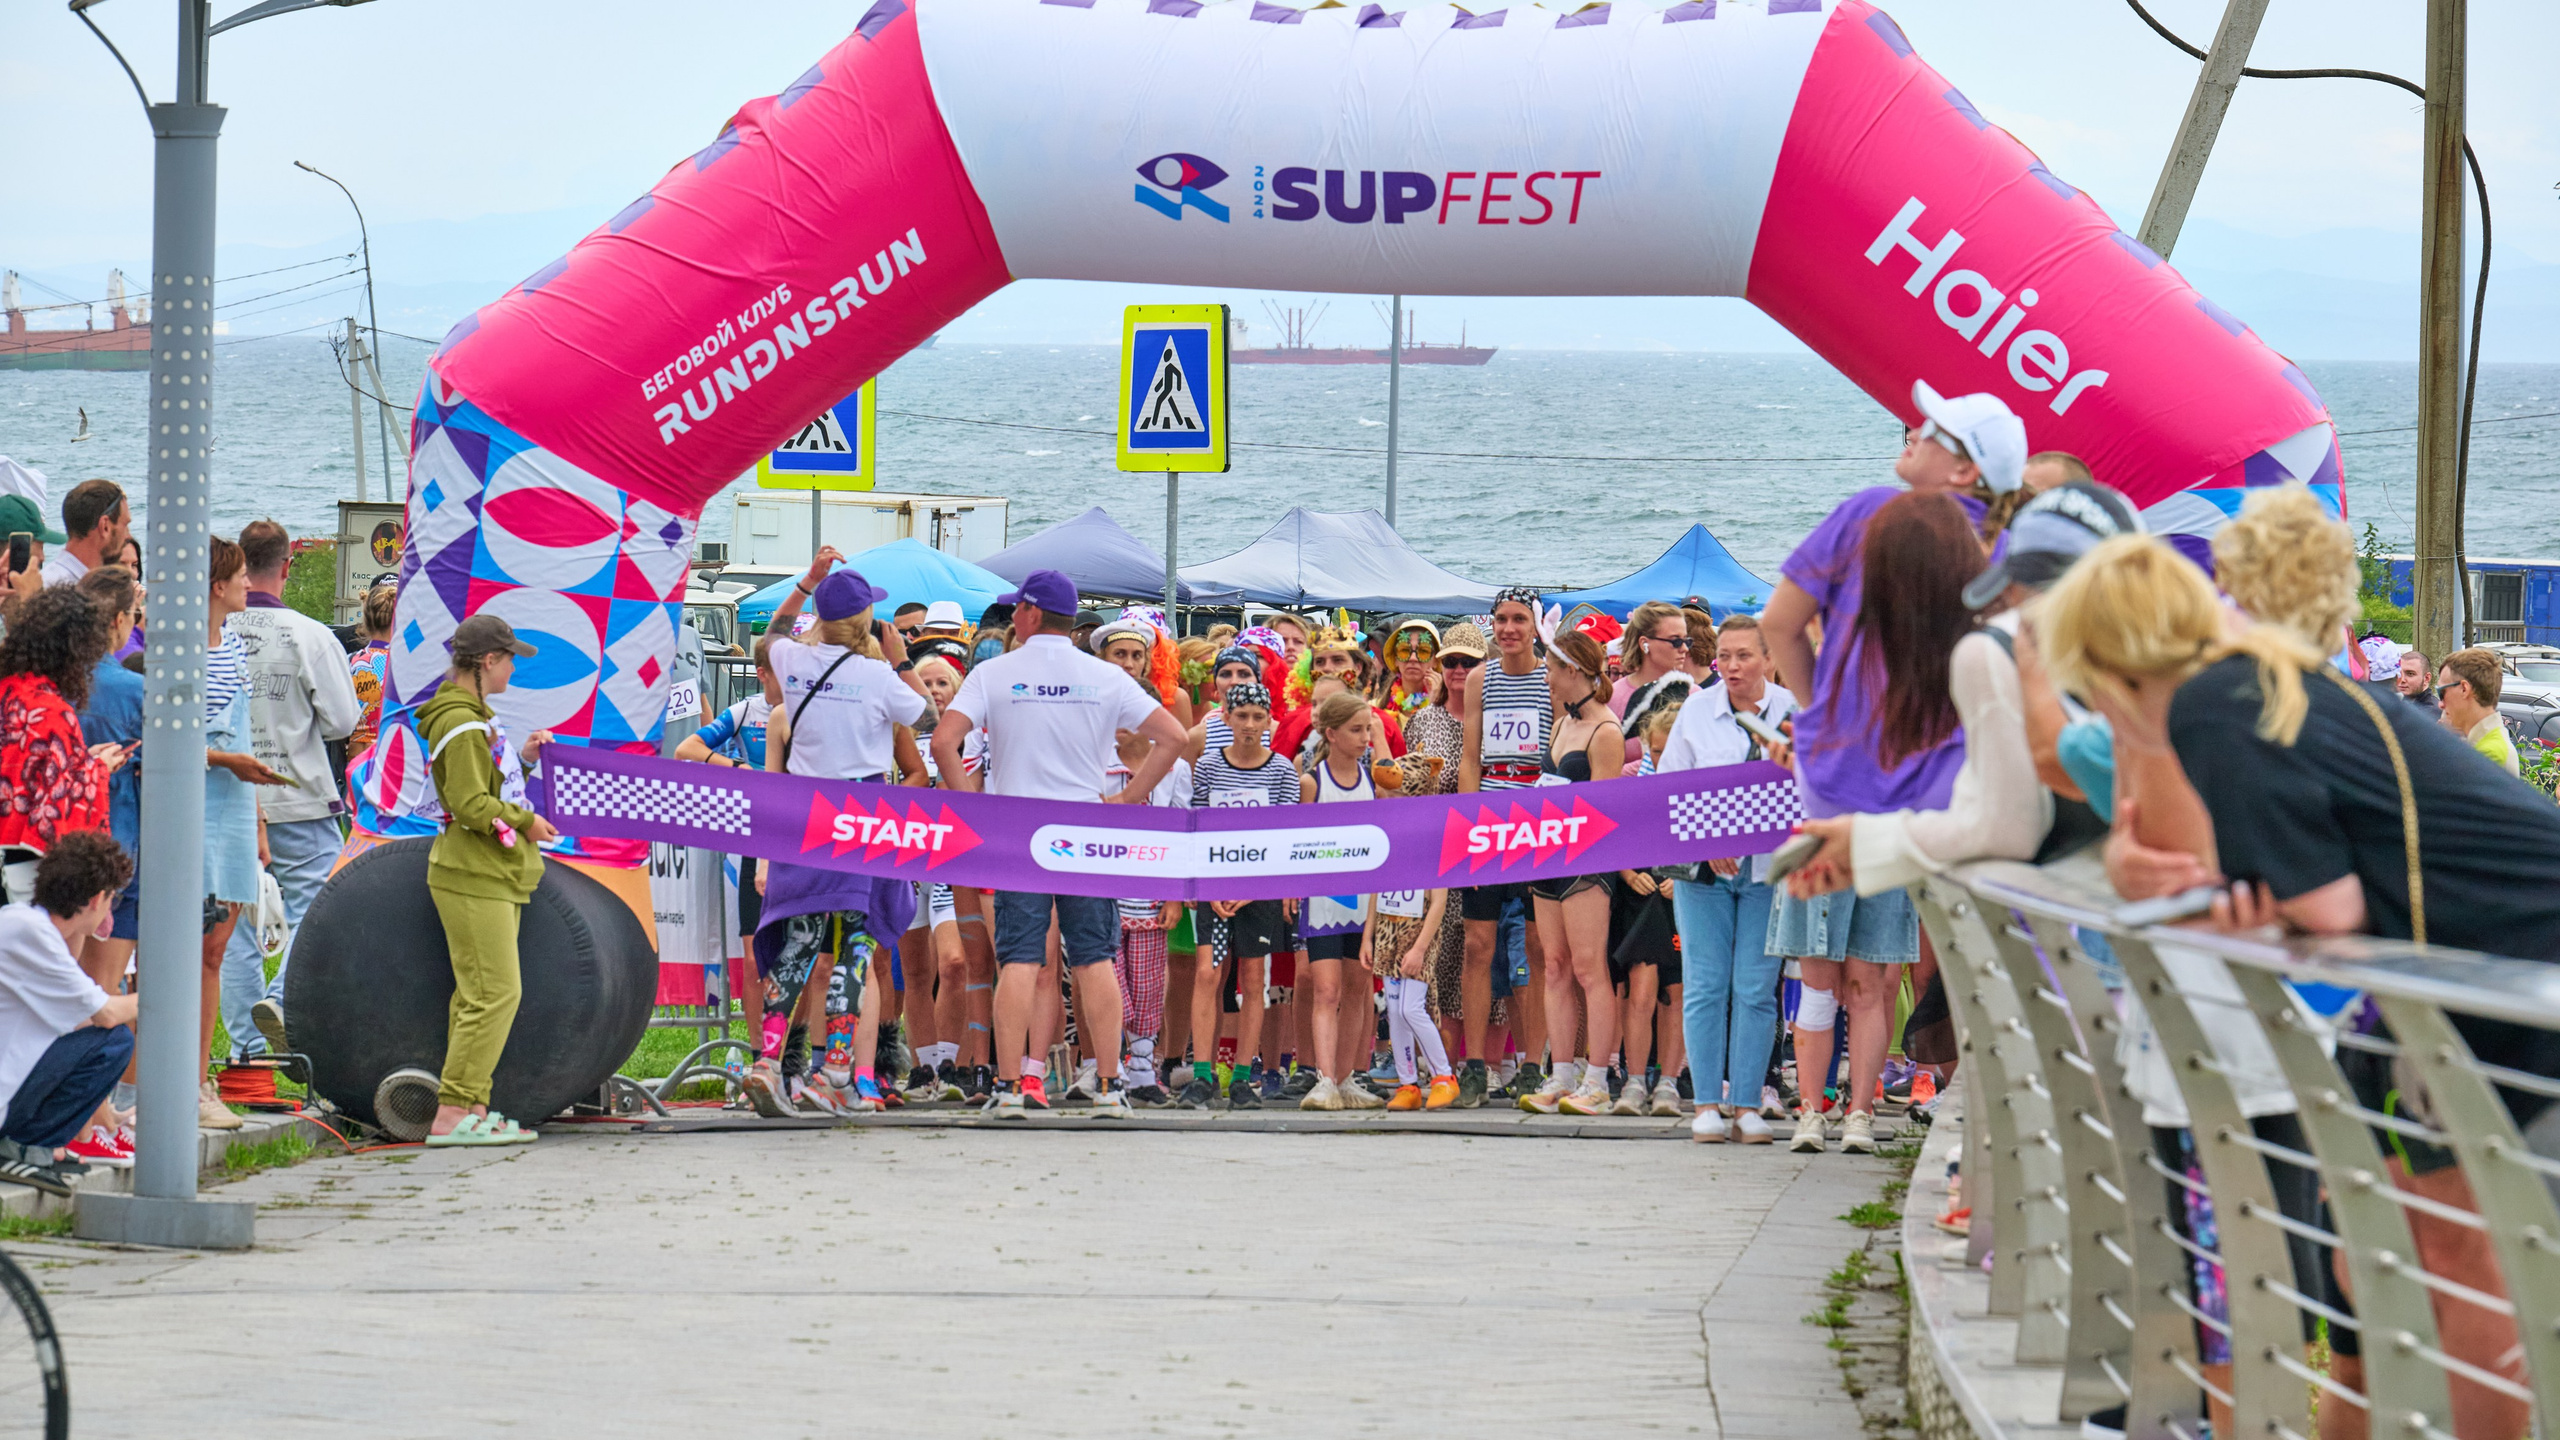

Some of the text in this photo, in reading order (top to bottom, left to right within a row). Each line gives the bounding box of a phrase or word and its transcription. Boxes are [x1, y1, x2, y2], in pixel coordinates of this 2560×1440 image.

[1253, 165, 1264, 219] 2024
[1271, 166, 1601, 225] SUPFEST
[1864, 195, 2110, 417] Haier
[640, 282, 793, 401] БЕГОВОЙ КЛУБ
[653, 227, 927, 446] RUNDNSRUN
[1037, 684, 1099, 697] SUPFEST
[1490, 721, 1531, 741] 470
[831, 813, 953, 851] START
[1467, 816, 1588, 854] START
[1084, 843, 1170, 861] SUPFEST
[1209, 845, 1267, 863] Haier
